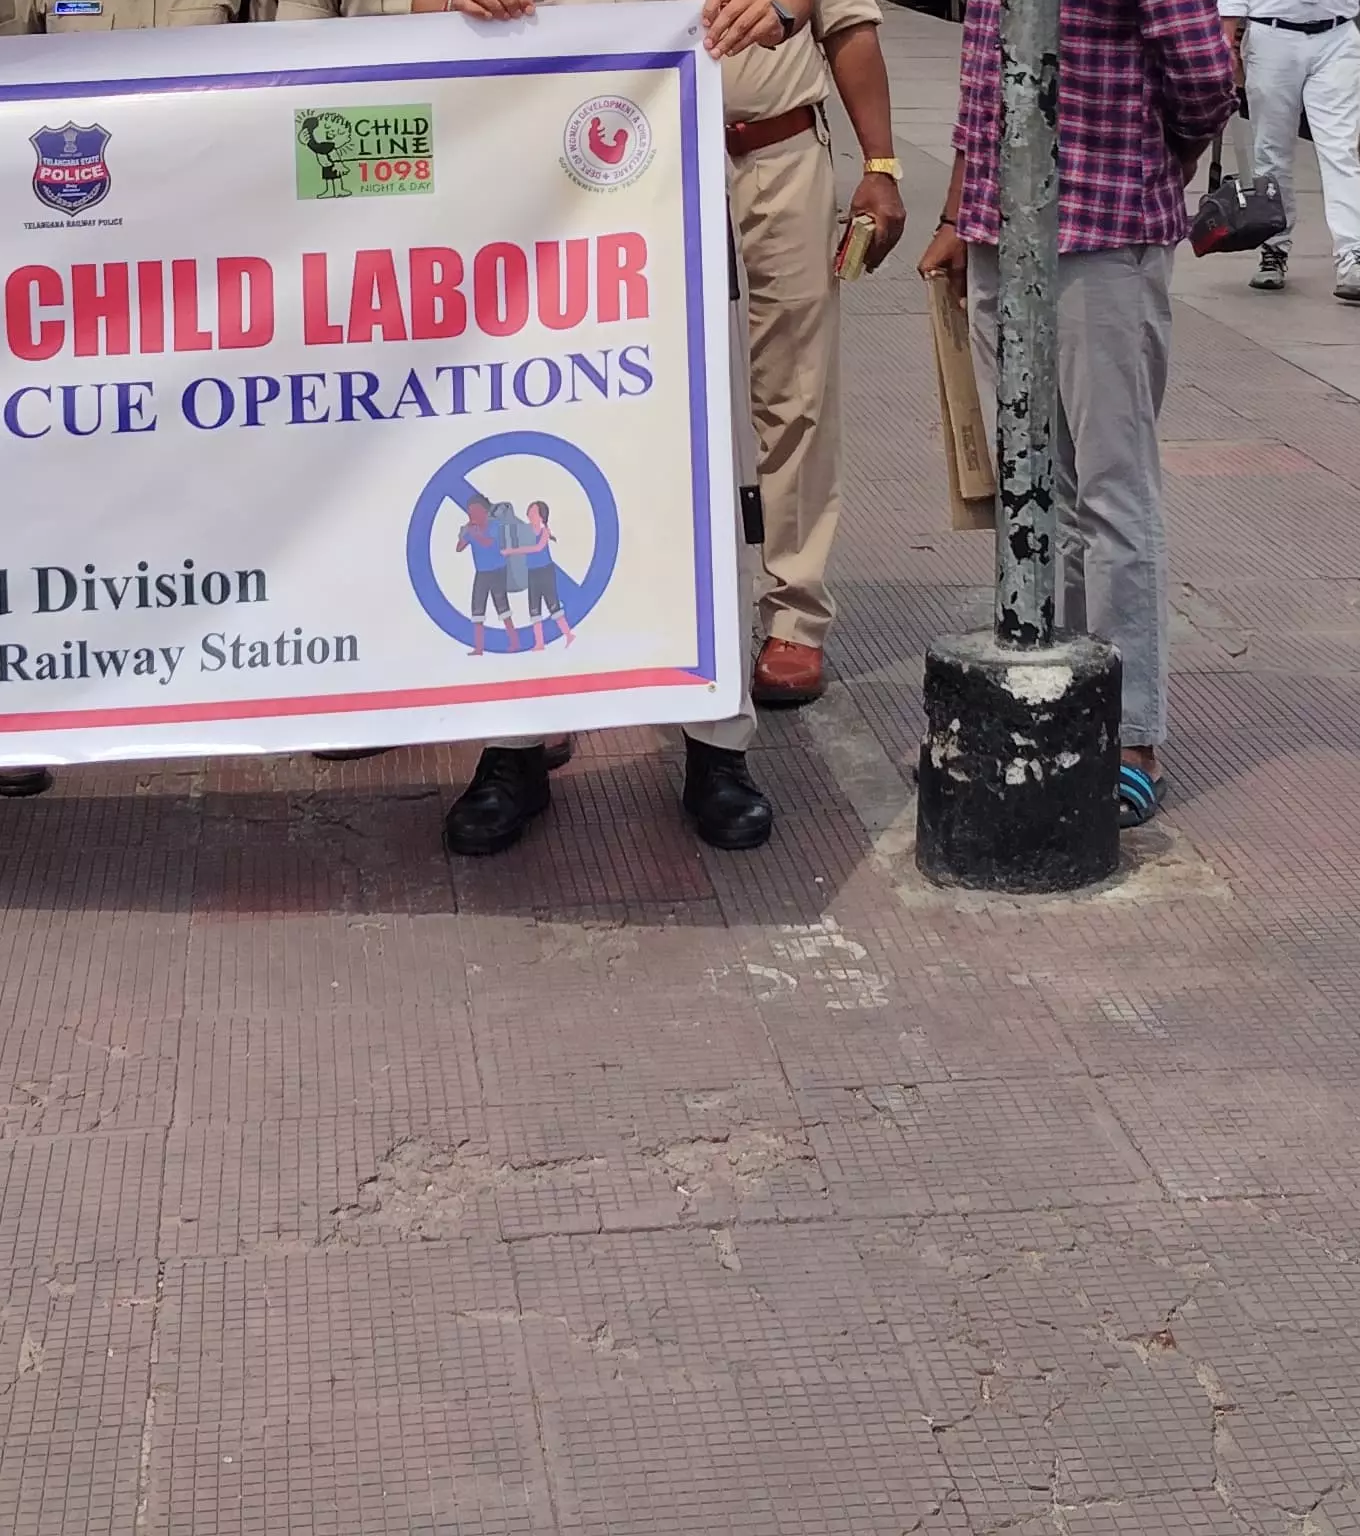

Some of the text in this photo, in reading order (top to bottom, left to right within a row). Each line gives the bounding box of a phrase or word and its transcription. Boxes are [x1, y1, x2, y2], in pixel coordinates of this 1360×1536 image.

[354, 117, 429, 137] CHILD
[358, 137, 430, 156] LINE
[40, 164, 105, 181] POLICE
[358, 160, 431, 182] 1098
[360, 183, 394, 193] NIGHT
[409, 181, 431, 192] DAY
[5, 257, 274, 362] CHILD
[303, 232, 649, 346] LABOUR
[181, 345, 654, 430] OPERATIONS
[32, 559, 268, 615] Division
[200, 628, 360, 671] Station
